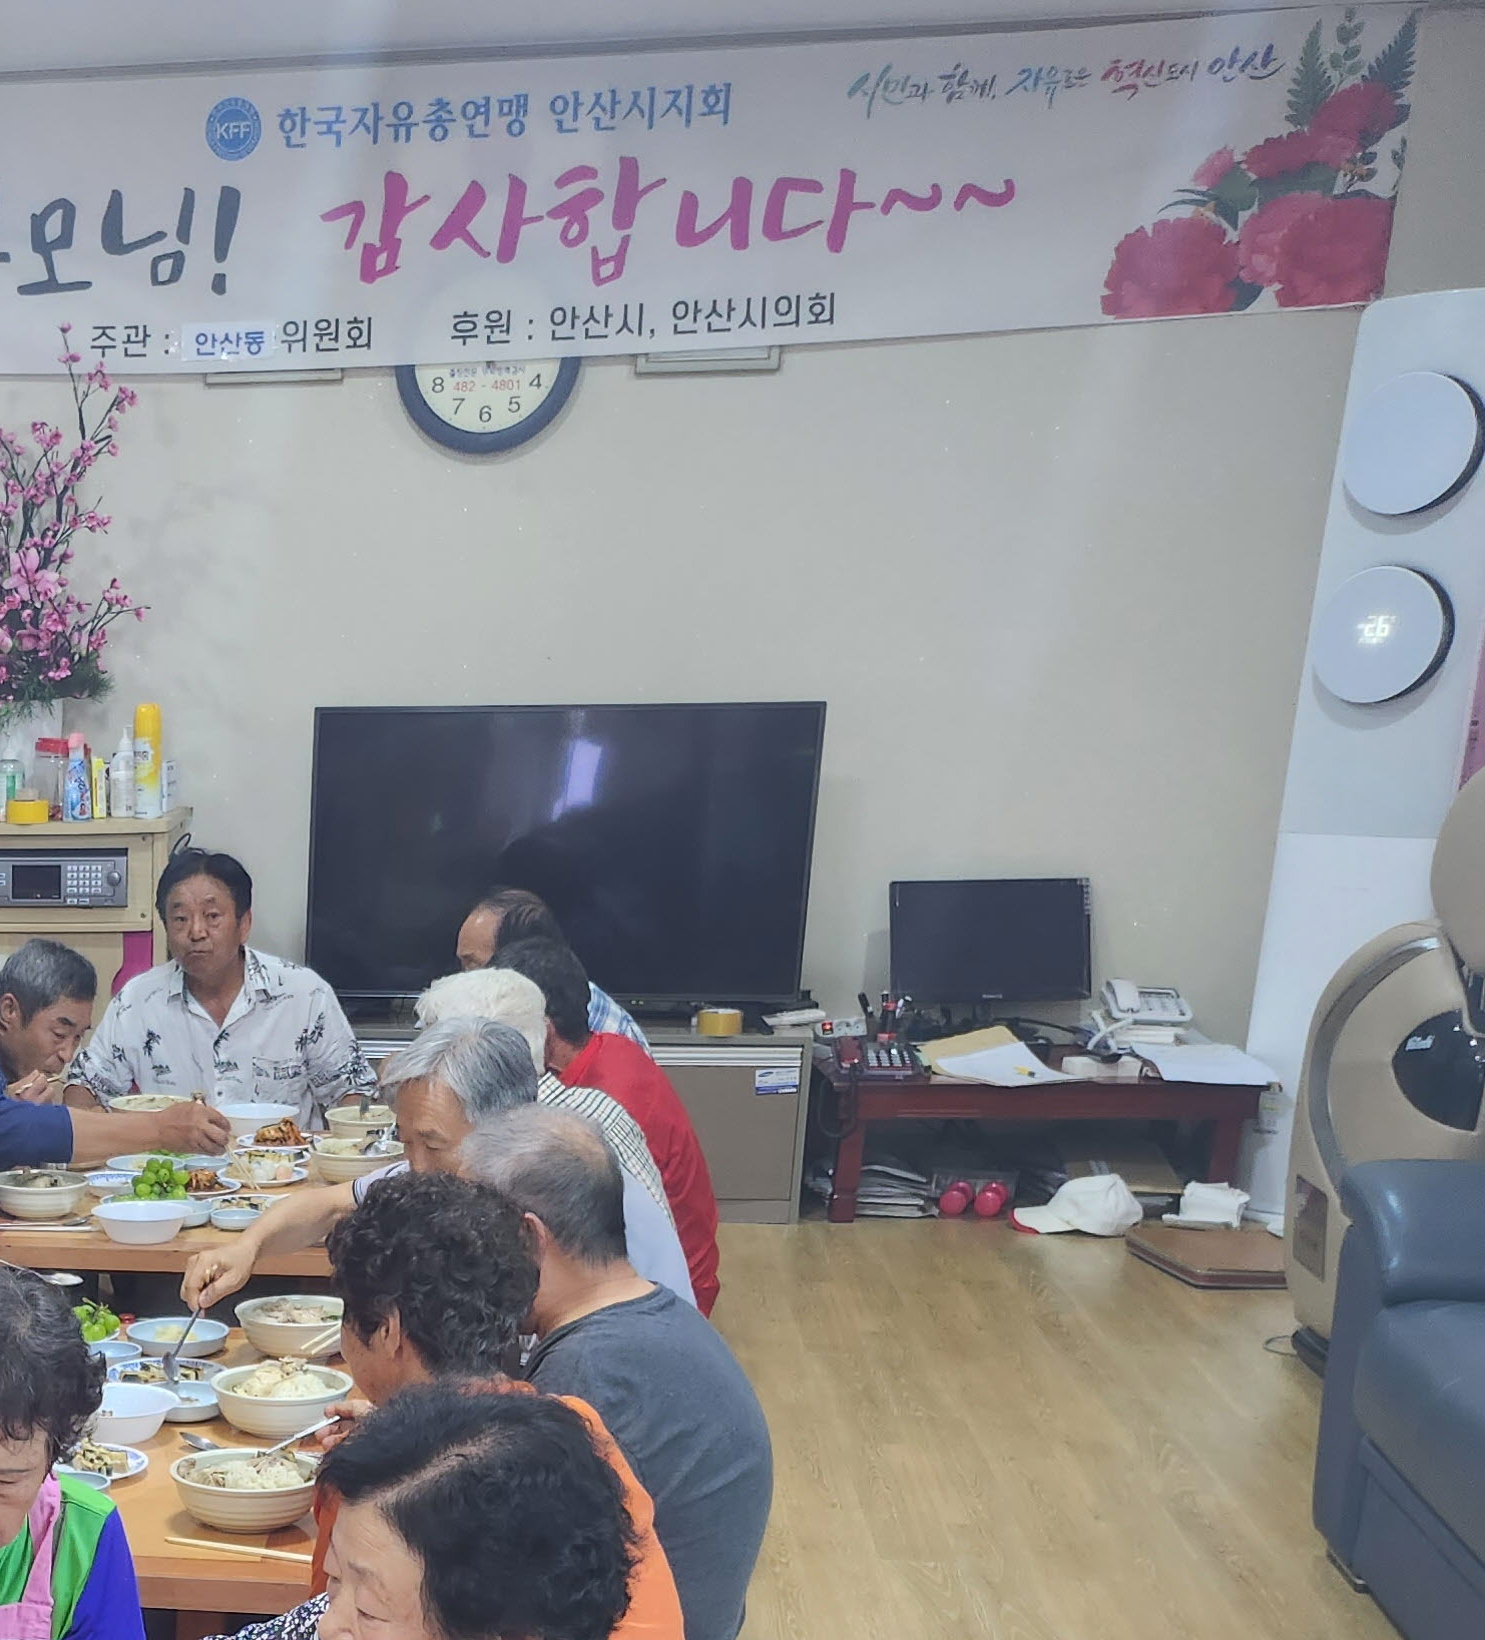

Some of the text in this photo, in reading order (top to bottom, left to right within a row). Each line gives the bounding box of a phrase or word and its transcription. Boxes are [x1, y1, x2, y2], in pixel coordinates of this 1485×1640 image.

[1207, 43, 1286, 83] 안산
[277, 82, 734, 149] 한국자유총연맹 안산시지회
[215, 121, 252, 140] KFF
[450, 309, 512, 347] 후원
[549, 302, 656, 343] 안산시,
[671, 291, 836, 336] 안산시의회
[90, 323, 152, 358] 주관
[195, 330, 266, 357] 안산동
[281, 316, 373, 353] 위원회
[431, 376, 445, 394] 8
[452, 380, 476, 393] 482
[491, 379, 521, 392] 4801
[528, 373, 542, 390] 4
[452, 397, 466, 416] 7
[478, 405, 492, 423] 6
[508, 395, 521, 414] 5
